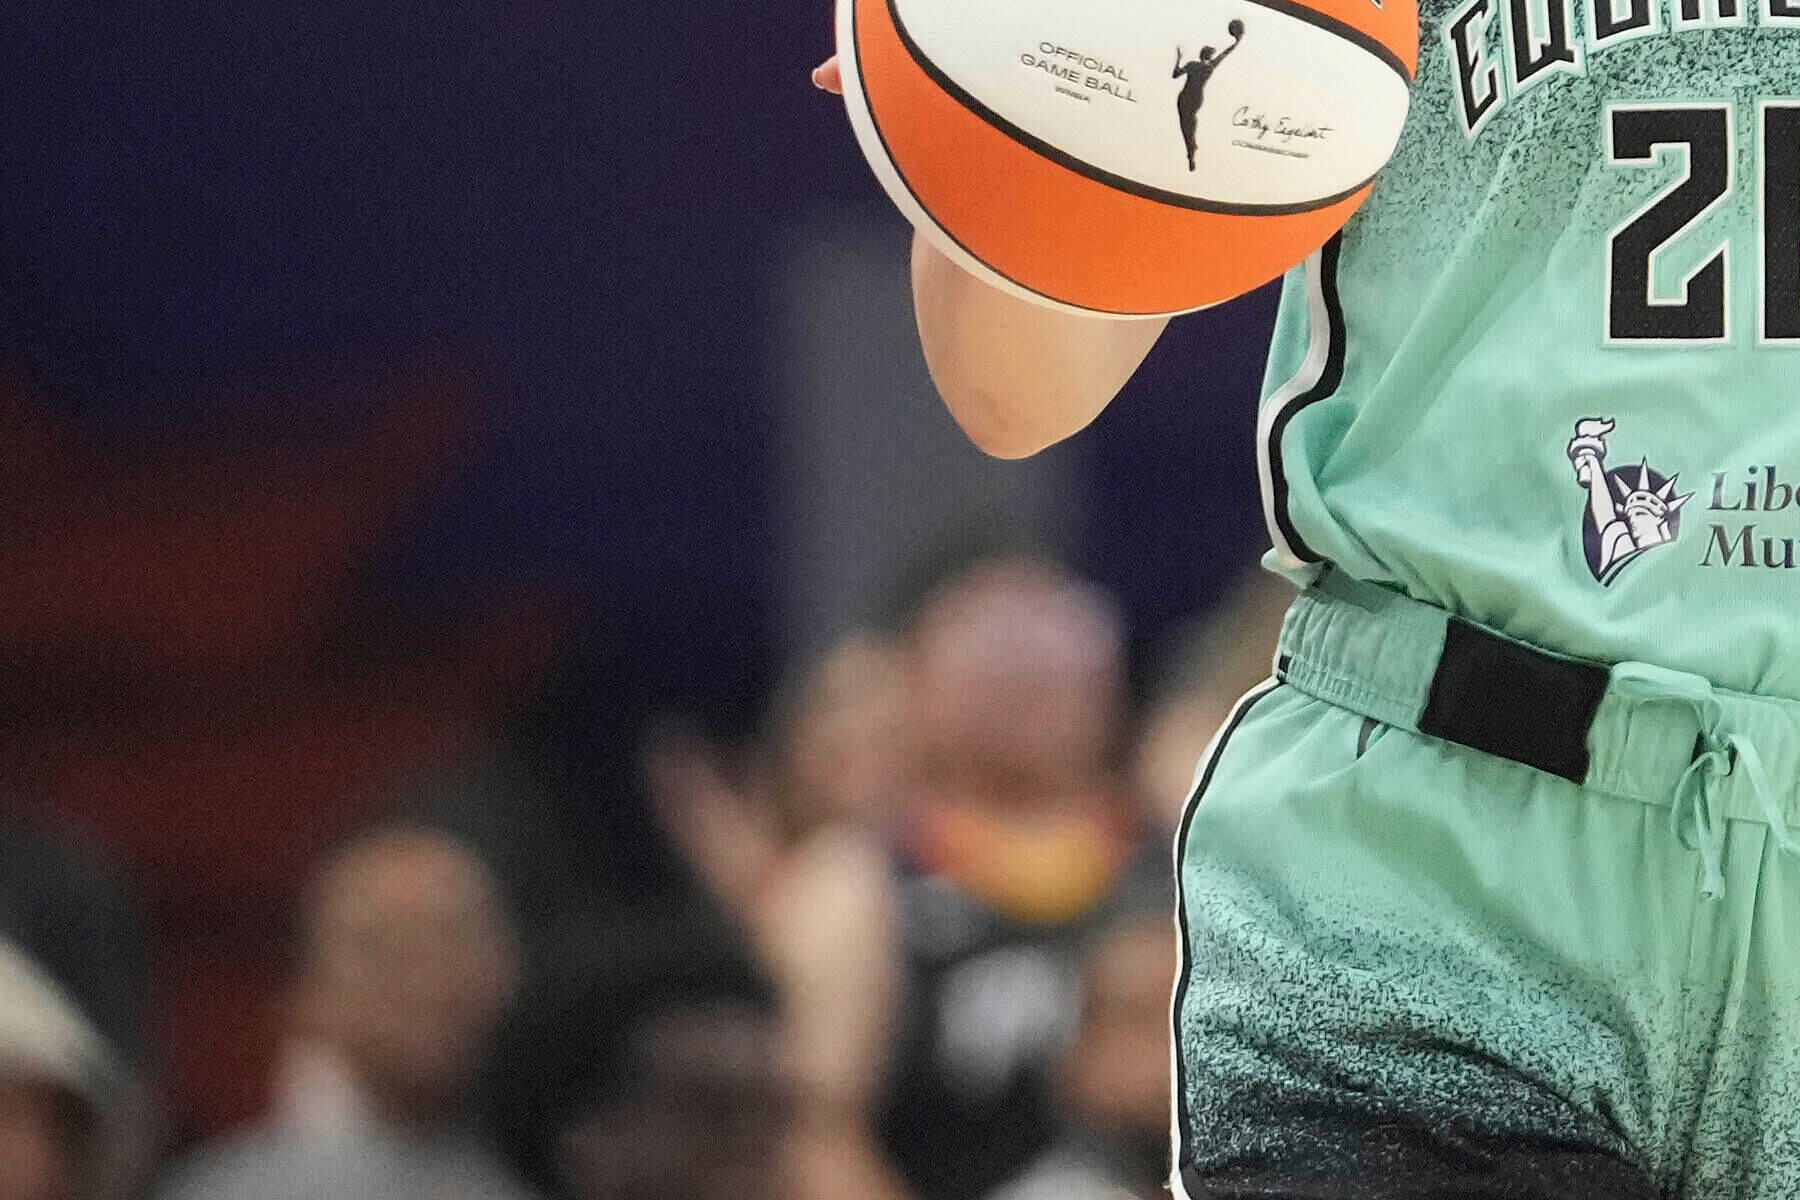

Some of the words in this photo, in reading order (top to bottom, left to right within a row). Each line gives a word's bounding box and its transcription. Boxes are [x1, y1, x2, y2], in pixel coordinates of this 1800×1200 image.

[1021, 53, 1081, 84] GAME
[1085, 76, 1138, 103] BALL
[1040, 41, 1129, 82] OFFICIAL
